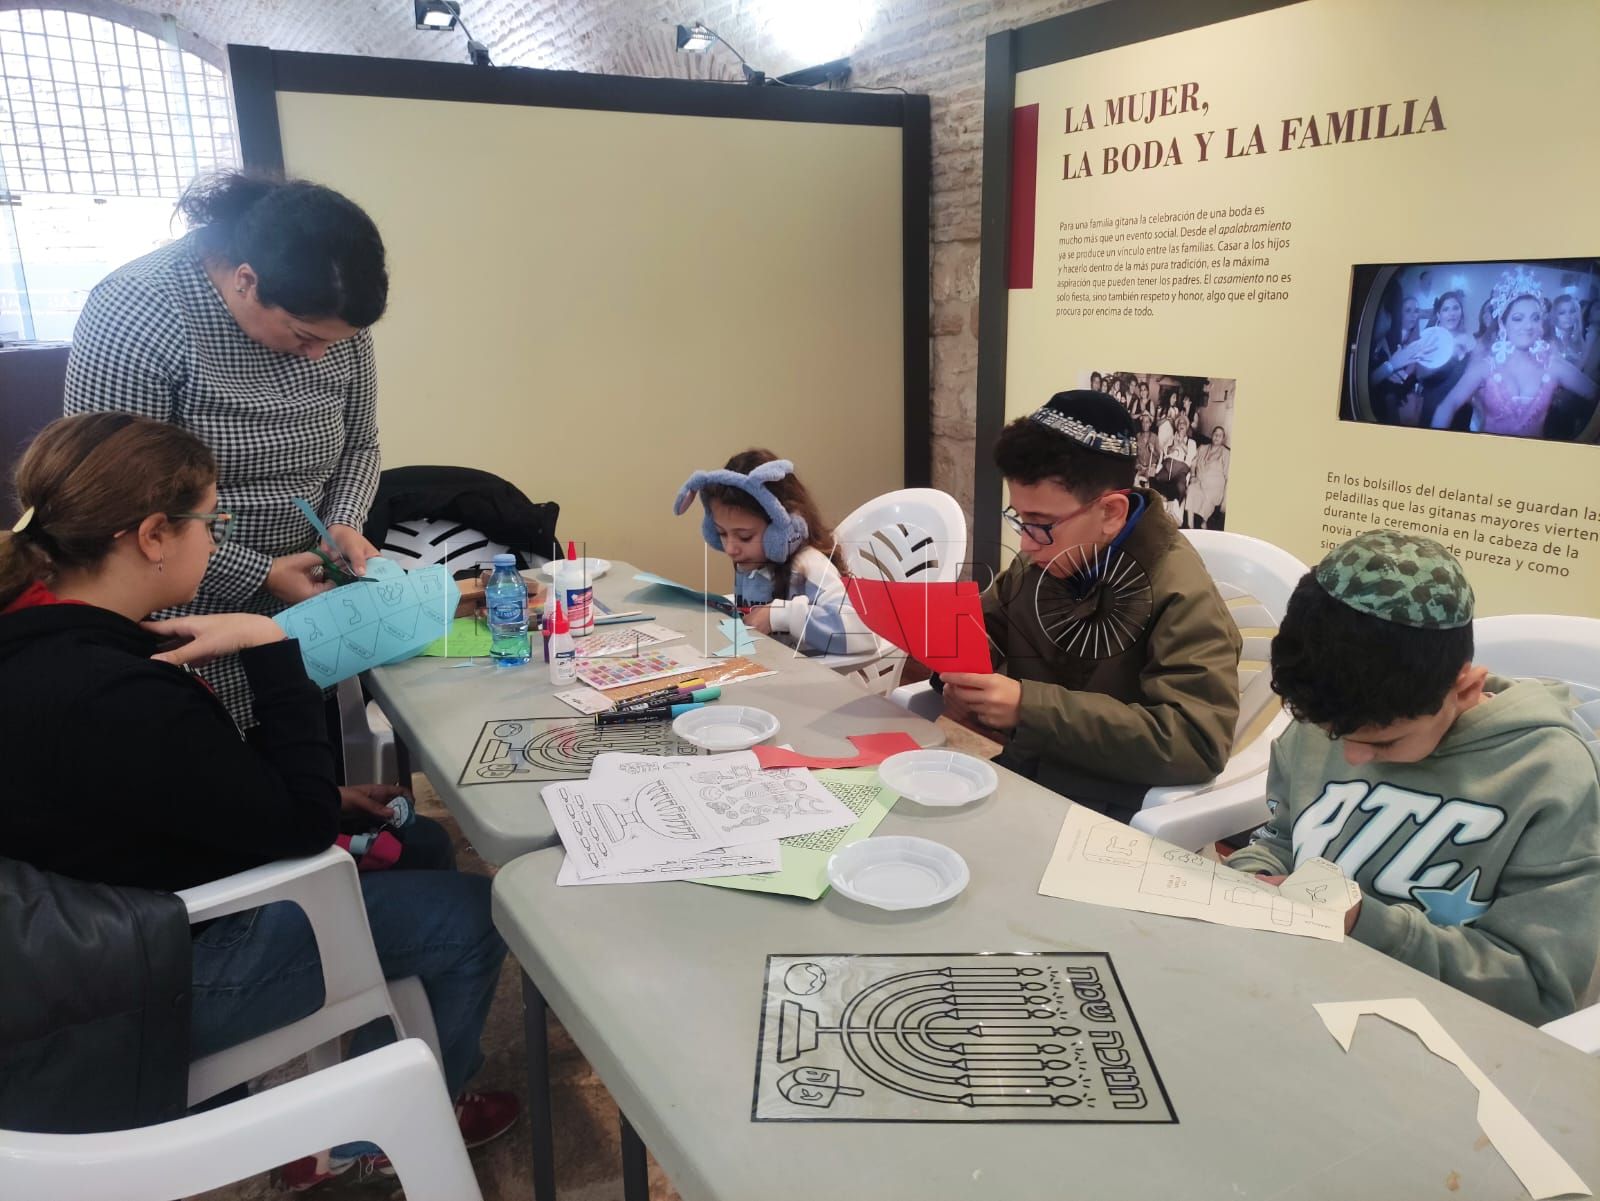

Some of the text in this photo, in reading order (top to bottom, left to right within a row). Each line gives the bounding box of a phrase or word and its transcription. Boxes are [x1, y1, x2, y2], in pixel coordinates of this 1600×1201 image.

[1064, 81, 1209, 134] LA MUJER,
[1062, 95, 1447, 180] LA BODA Y LA FAMILIA
[1060, 222, 1074, 231] Para
[1090, 218, 1113, 228] familia
[1115, 217, 1138, 228] gitana
[1140, 214, 1146, 224] la
[1149, 211, 1194, 223] celebración
[1197, 209, 1208, 220] de
[1210, 210, 1226, 218] una
[1229, 205, 1252, 217] boda
[1255, 207, 1264, 215] es
[1059, 236, 1082, 245] mucho
[1084, 234, 1098, 243] más
[1100, 234, 1113, 244] que
[1127, 231, 1152, 240] evento
[1154, 228, 1178, 239] social.
[1181, 226, 1206, 237] Desde
[1209, 224, 1216, 235] el
[1218, 221, 1291, 236] apalabramiento
[1059, 251, 1066, 261] ya
[1076, 248, 1104, 259] produce
[1106, 249, 1115, 257] un
[1146, 246, 1166, 255] entre
[1169, 243, 1179, 253] las
[1181, 242, 1215, 253] familias.
[1218, 241, 1241, 251] Casar
[1244, 242, 1249, 250] a
[1251, 238, 1264, 249] los
[1267, 237, 1290, 251] hijos
[1058, 255, 1269, 275] y hacerlo dentro de la más pura tradición, es la máxima
[1057, 274, 1291, 289] aspiración que pueden tener los padres. El casamiento no es
[1071, 292, 1090, 302] fiesta,
[1109, 292, 1138, 301] también
[1140, 292, 1169, 303] respeto
[1171, 293, 1176, 303] y
[1178, 291, 1204, 301] honor,
[1206, 291, 1225, 303] algo
[1228, 292, 1245, 302] que
[1247, 290, 1256, 300] el
[1258, 290, 1288, 303] gitano
[1056, 306, 1154, 317] procura por encima de todo.
[1327, 472, 1340, 484] En
[1344, 474, 1359, 486] los
[1363, 476, 1412, 494] bolsillos
[1416, 484, 1435, 497] del
[1439, 488, 1493, 505] delantal
[1497, 498, 1512, 508] se
[1516, 503, 1578, 518] guardan
[1325, 490, 1599, 542] peladillas que las gitanas mayores vierten
[1322, 524, 1352, 537] novia
[1324, 505, 1579, 559] durante la ceremonia en la cabeza de la
[1465, 550, 1511, 566] pureza
[1515, 559, 1524, 571] y
[1528, 561, 1570, 577] como
[1067, 967, 1149, 1110] חנוכה שמח
